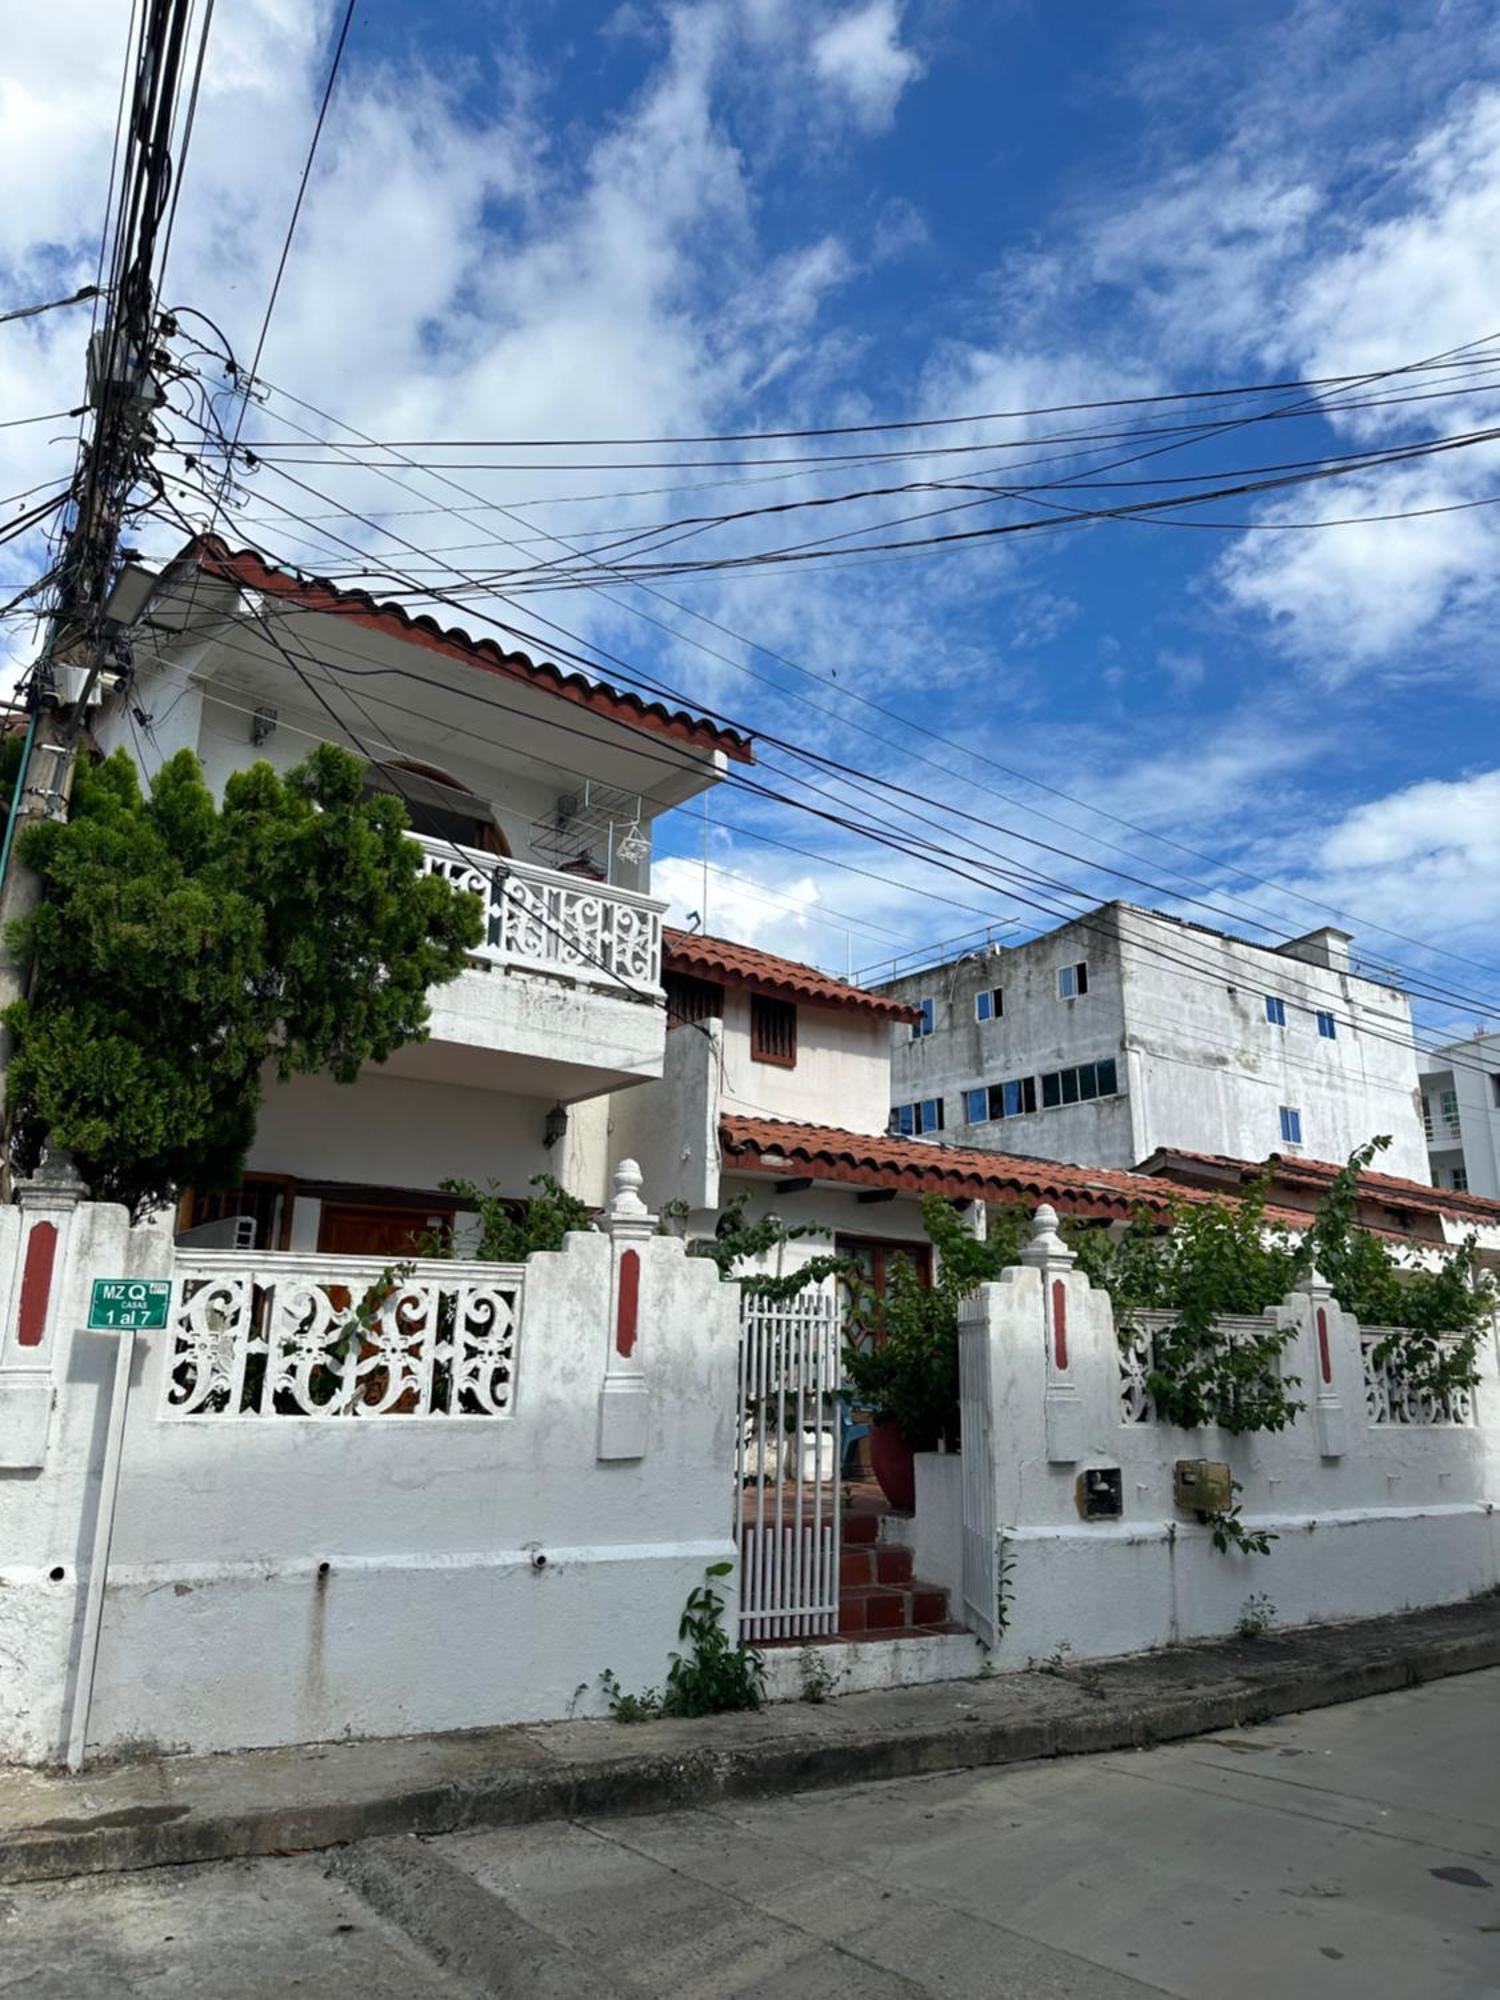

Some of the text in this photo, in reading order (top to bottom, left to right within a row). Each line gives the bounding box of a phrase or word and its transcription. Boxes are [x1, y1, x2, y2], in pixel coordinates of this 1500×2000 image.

[103, 1285, 125, 1299] MZ
[128, 1285, 146, 1300] Q
[121, 1301, 147, 1309] CASAS
[106, 1310, 151, 1324] 1 al 7
